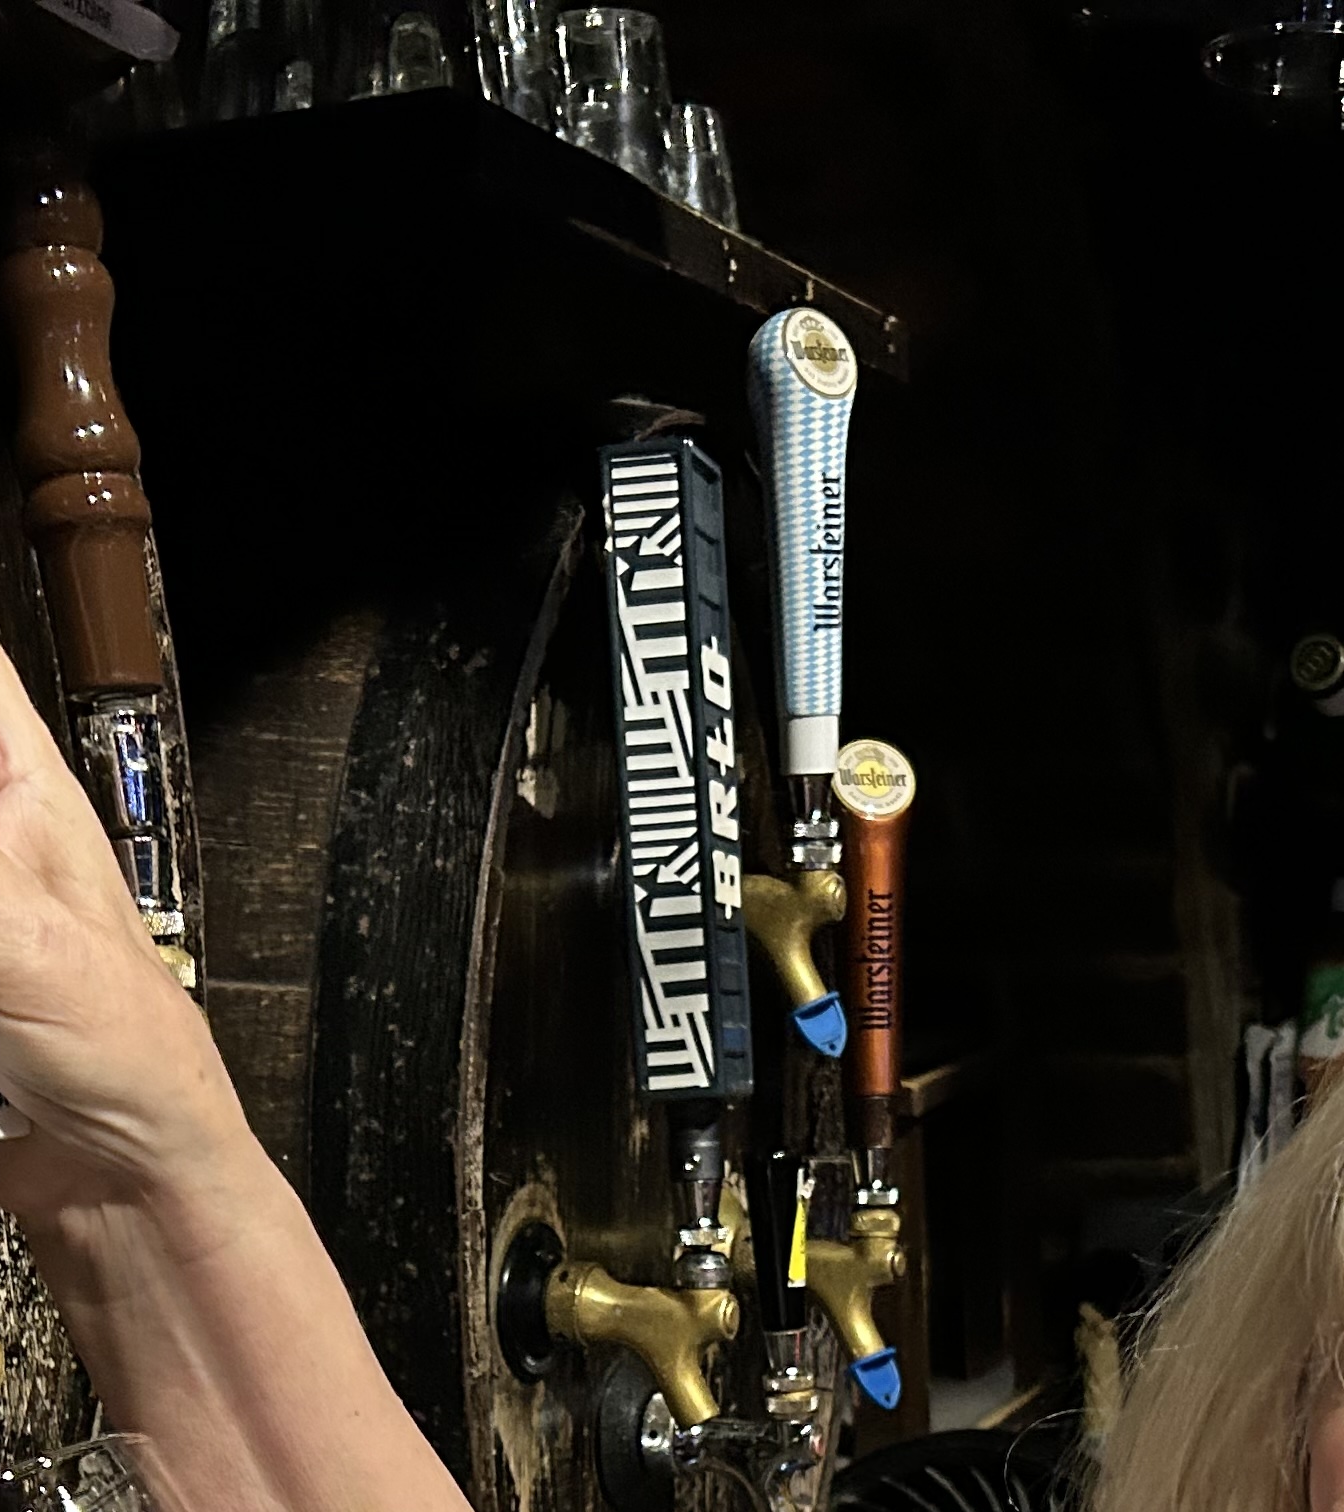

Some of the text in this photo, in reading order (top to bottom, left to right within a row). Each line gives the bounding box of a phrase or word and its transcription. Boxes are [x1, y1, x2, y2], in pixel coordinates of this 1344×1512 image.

[809, 472, 843, 632] Warsteiner
[839, 767, 907, 788] Warsteiner
[859, 889, 895, 1031] Warsteiner
